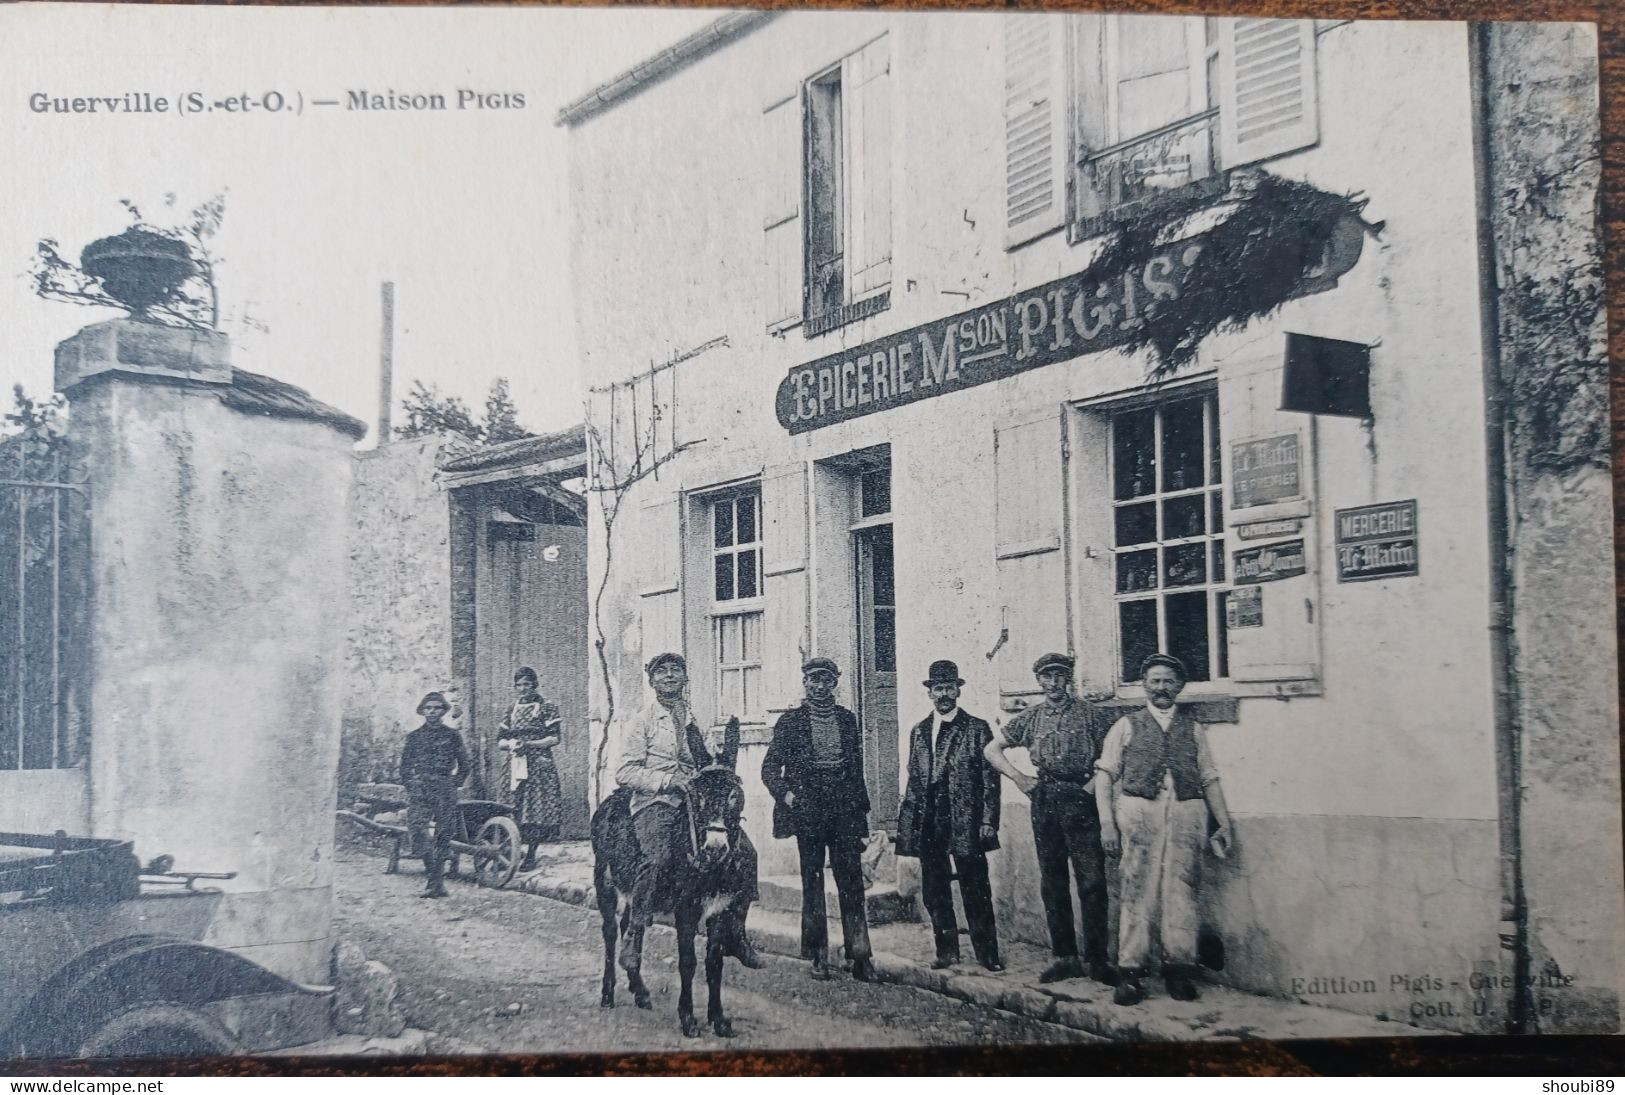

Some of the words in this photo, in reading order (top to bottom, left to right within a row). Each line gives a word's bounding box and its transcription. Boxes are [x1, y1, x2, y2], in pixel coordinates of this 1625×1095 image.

[788, 341, 913, 424] EPICERIE
[1341, 508, 1412, 539] MERCERIE
[1361, 542, 1413, 571] Matin
